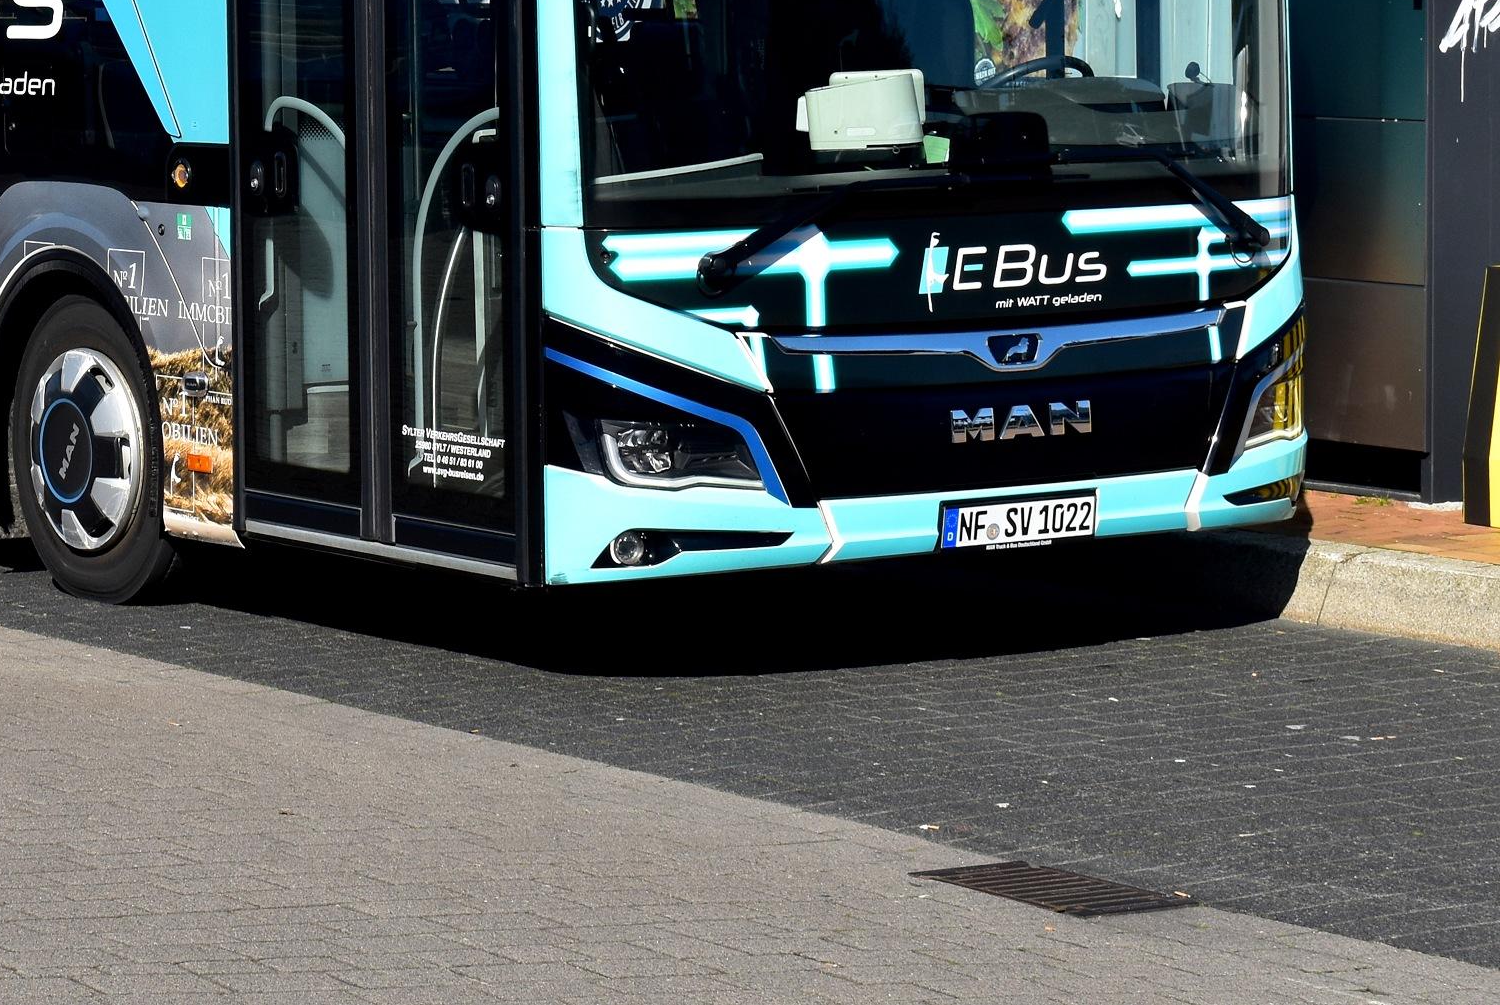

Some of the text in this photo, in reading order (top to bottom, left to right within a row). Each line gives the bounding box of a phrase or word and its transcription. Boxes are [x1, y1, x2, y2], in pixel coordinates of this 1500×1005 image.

[113, 262, 137, 289] Nº1
[996, 292, 1102, 309] mit WATT geladen
[161, 421, 218, 446] OBILIEN
[950, 400, 1092, 443] MAN
[58, 422, 80, 481] MAN
[449, 456, 456, 466] 51
[451, 444, 492, 459] WESTERLAND
[947, 501, 1092, 542] D NF SV 1022
